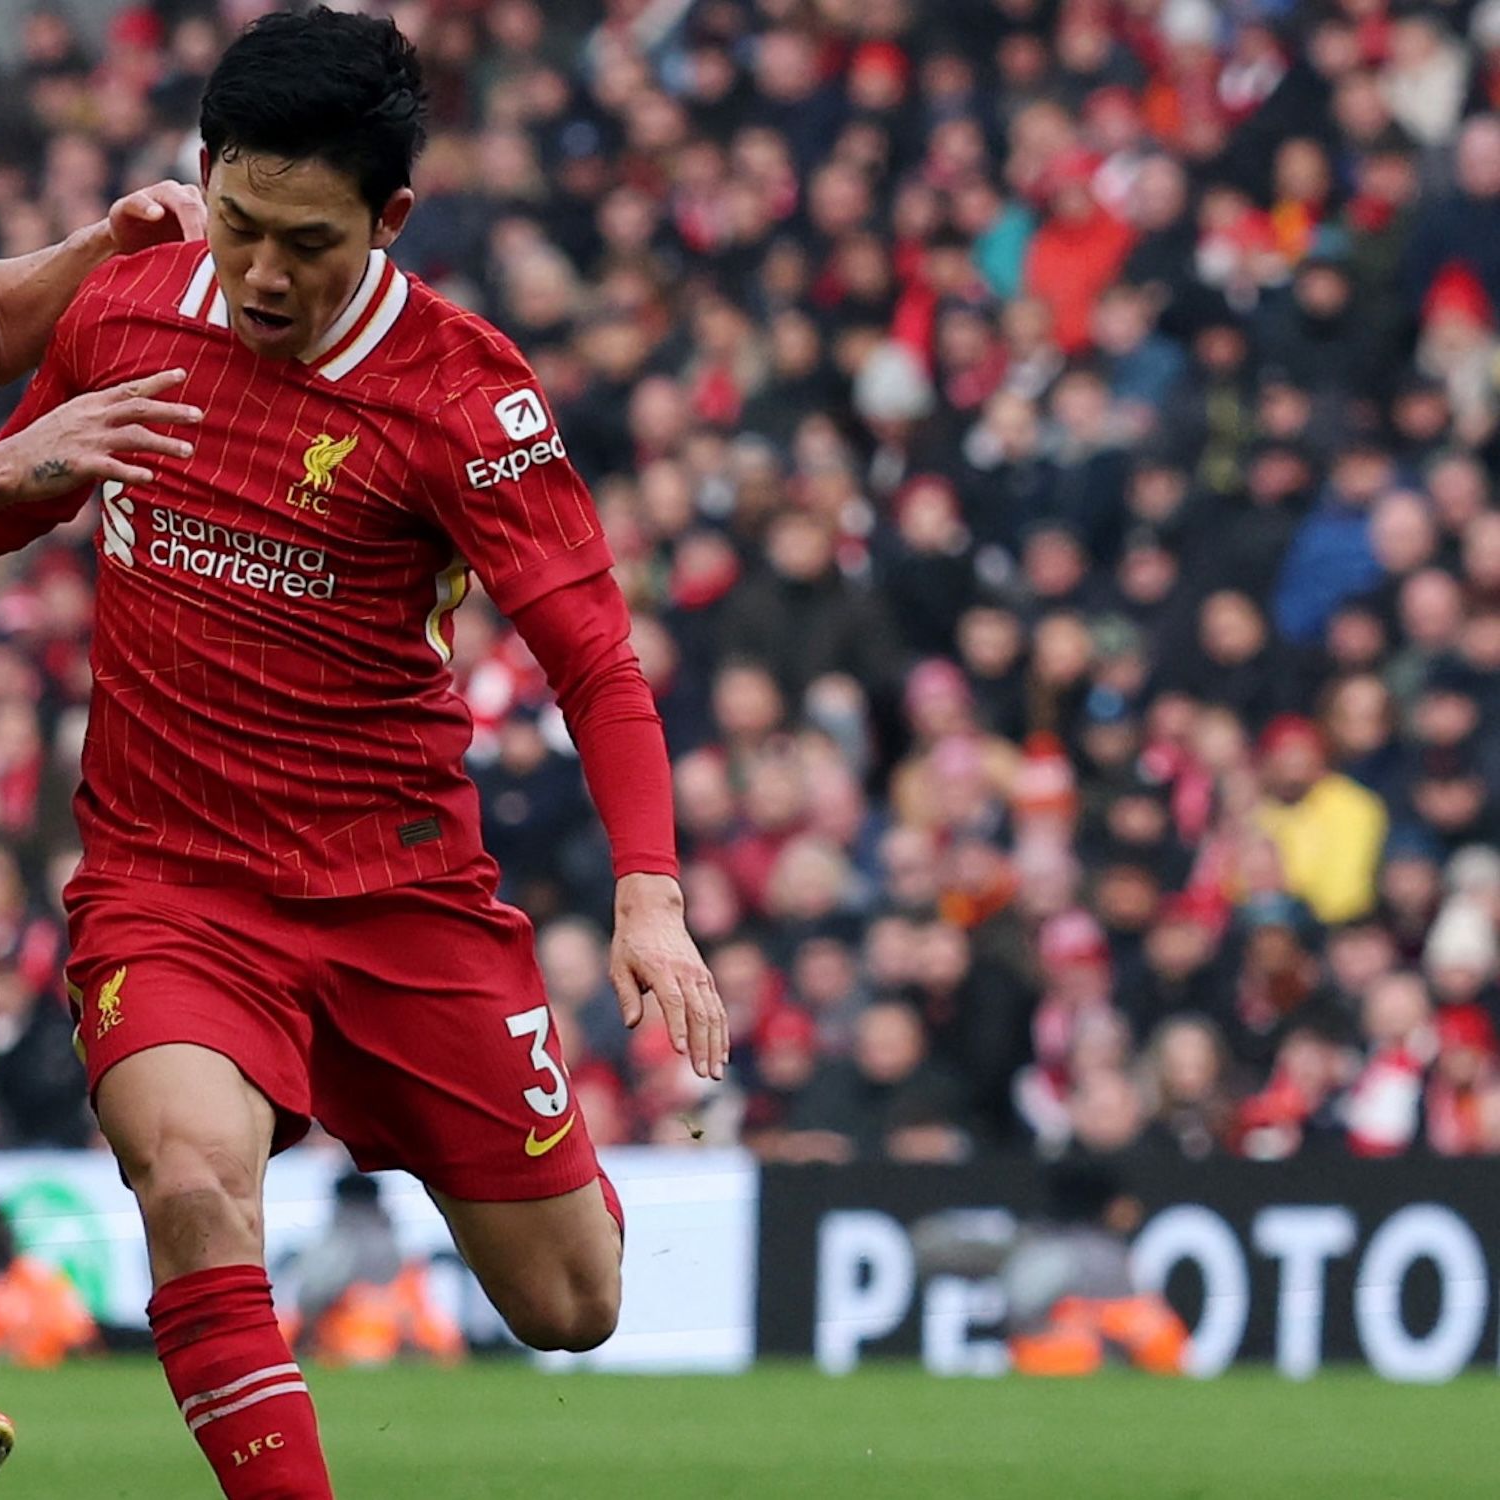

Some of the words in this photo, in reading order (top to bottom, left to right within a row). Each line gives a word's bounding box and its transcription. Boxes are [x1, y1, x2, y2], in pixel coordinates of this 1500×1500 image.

[149, 537, 335, 600] chartered
[151, 508, 326, 573] standard
[504, 1005, 569, 1118] 3
[231, 1432, 285, 1467] LFC
